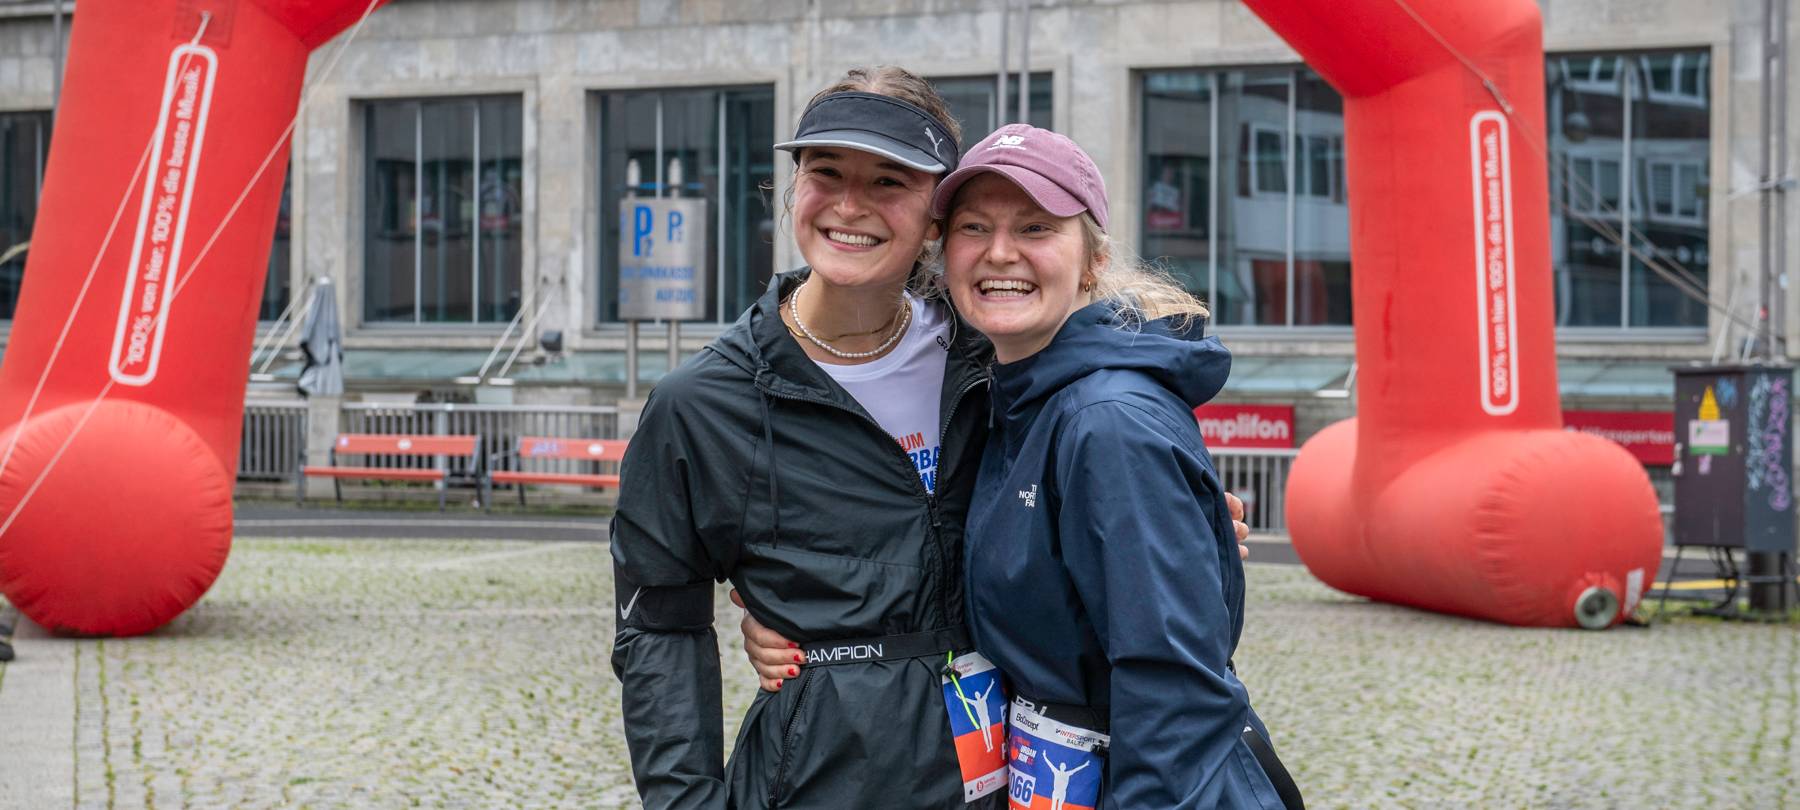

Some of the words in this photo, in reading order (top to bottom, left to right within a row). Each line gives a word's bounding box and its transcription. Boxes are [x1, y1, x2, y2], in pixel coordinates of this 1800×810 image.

[166, 119, 190, 168] beste
[162, 168, 181, 194] die
[152, 194, 176, 244] 100%
[1488, 222, 1502, 246] die
[1489, 244, 1504, 291] 100%
[142, 282, 158, 312] von
[128, 314, 152, 365] 100%
[936, 335, 949, 351] CR
[1494, 323, 1506, 351] von
[1492, 351, 1507, 398] 100%
[897, 432, 925, 453] UM
[1200, 413, 1289, 444] mplifon
[1025, 499, 1036, 508] FA
[1008, 770, 1033, 803] 066
